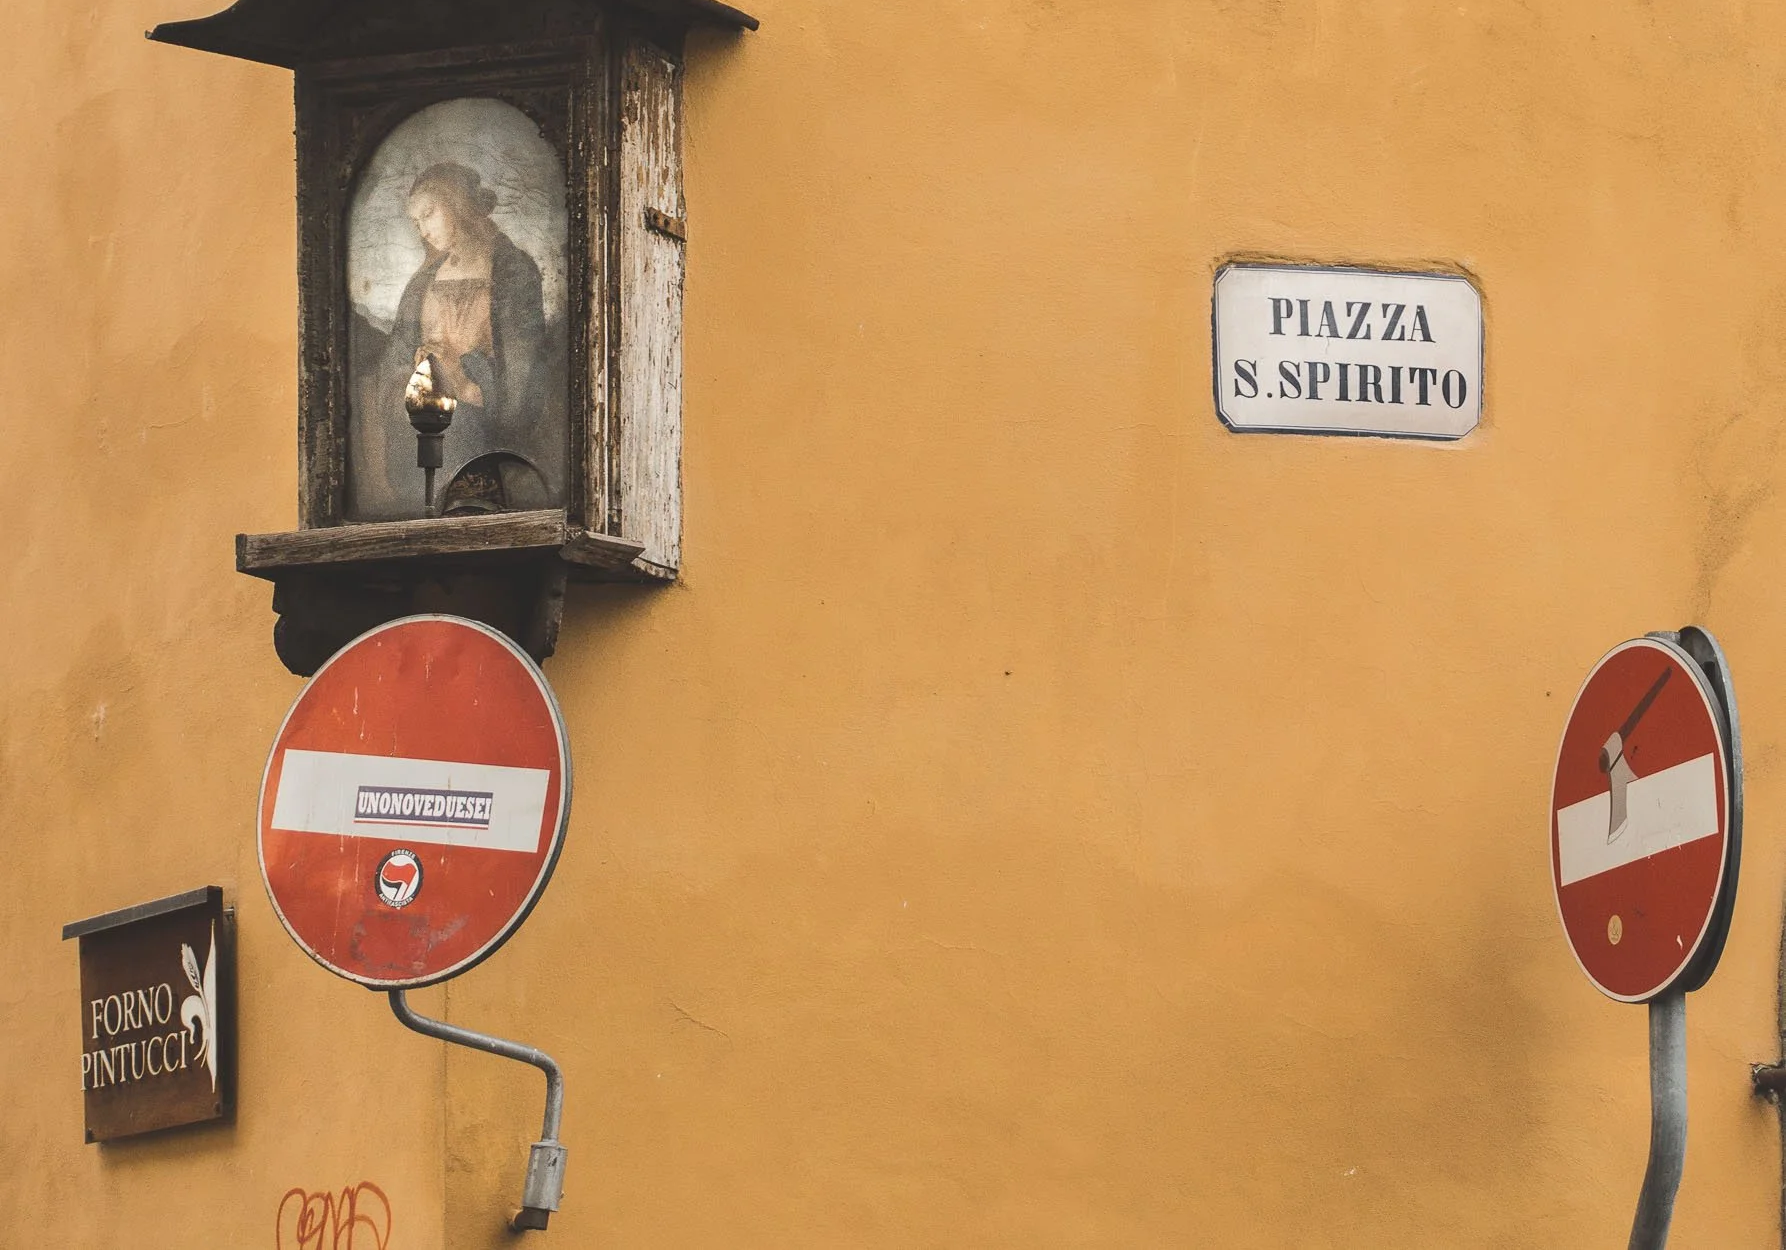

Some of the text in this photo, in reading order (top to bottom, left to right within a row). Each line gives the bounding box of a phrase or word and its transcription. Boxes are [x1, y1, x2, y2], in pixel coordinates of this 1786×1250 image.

[1267, 297, 1436, 343] PIAZZA
[357, 791, 492, 820] UNONOVEDUESEI
[391, 849, 416, 859] FIRENZE
[91, 983, 172, 1039] FORNO
[80, 1030, 187, 1091] PINTUCCI
